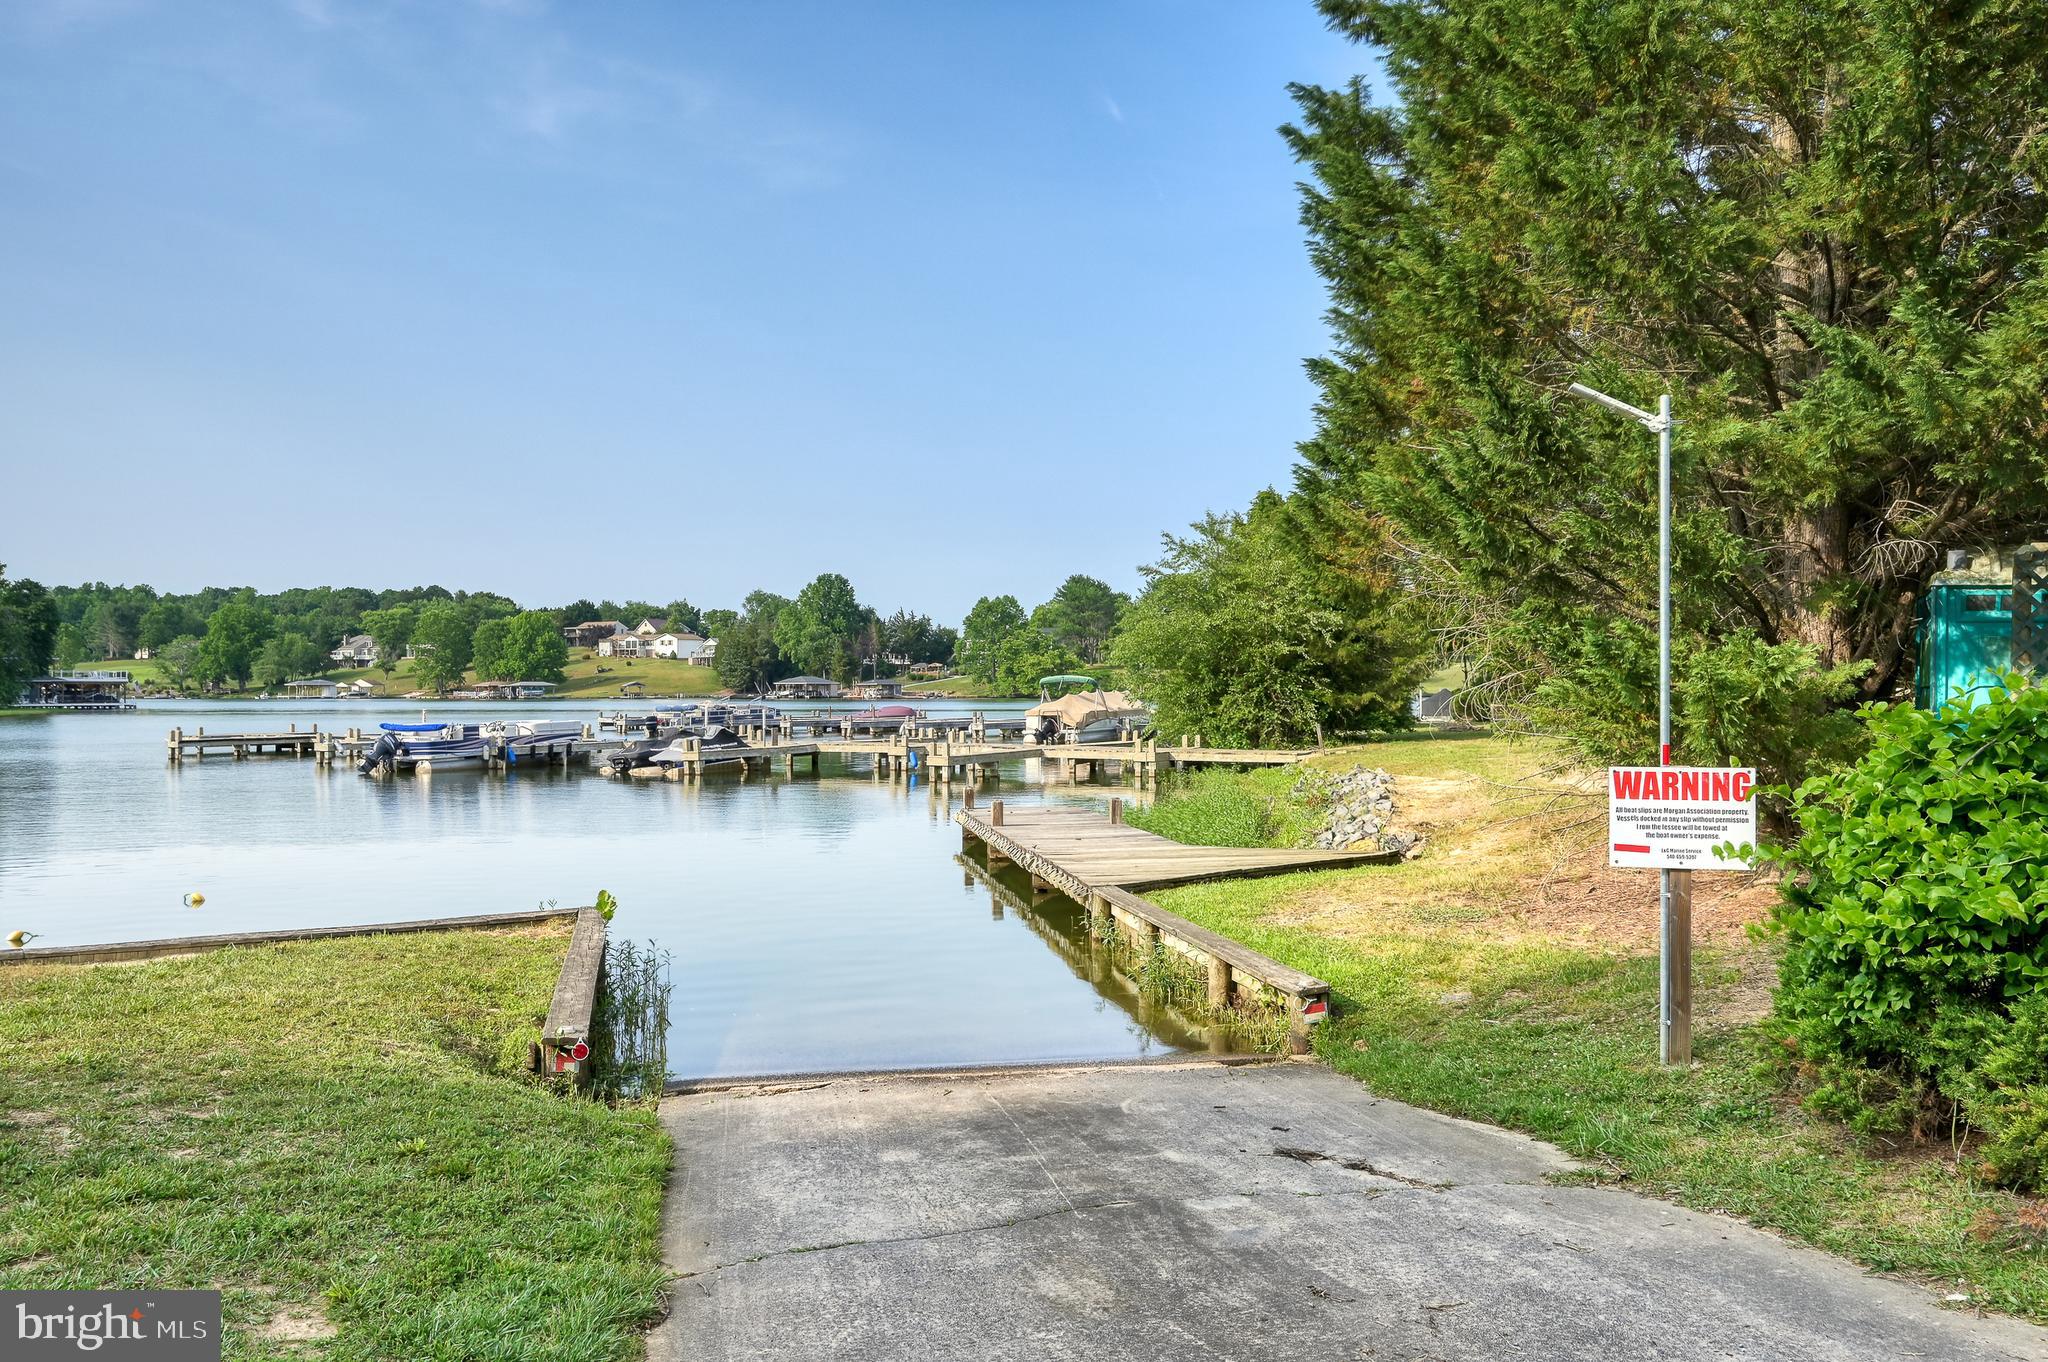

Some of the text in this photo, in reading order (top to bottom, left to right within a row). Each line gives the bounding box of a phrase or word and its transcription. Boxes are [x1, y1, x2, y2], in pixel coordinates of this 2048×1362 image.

[1613, 771, 1751, 802] WARNING
[1638, 807, 1652, 815] slips
[1663, 807, 1685, 815] Morgan
